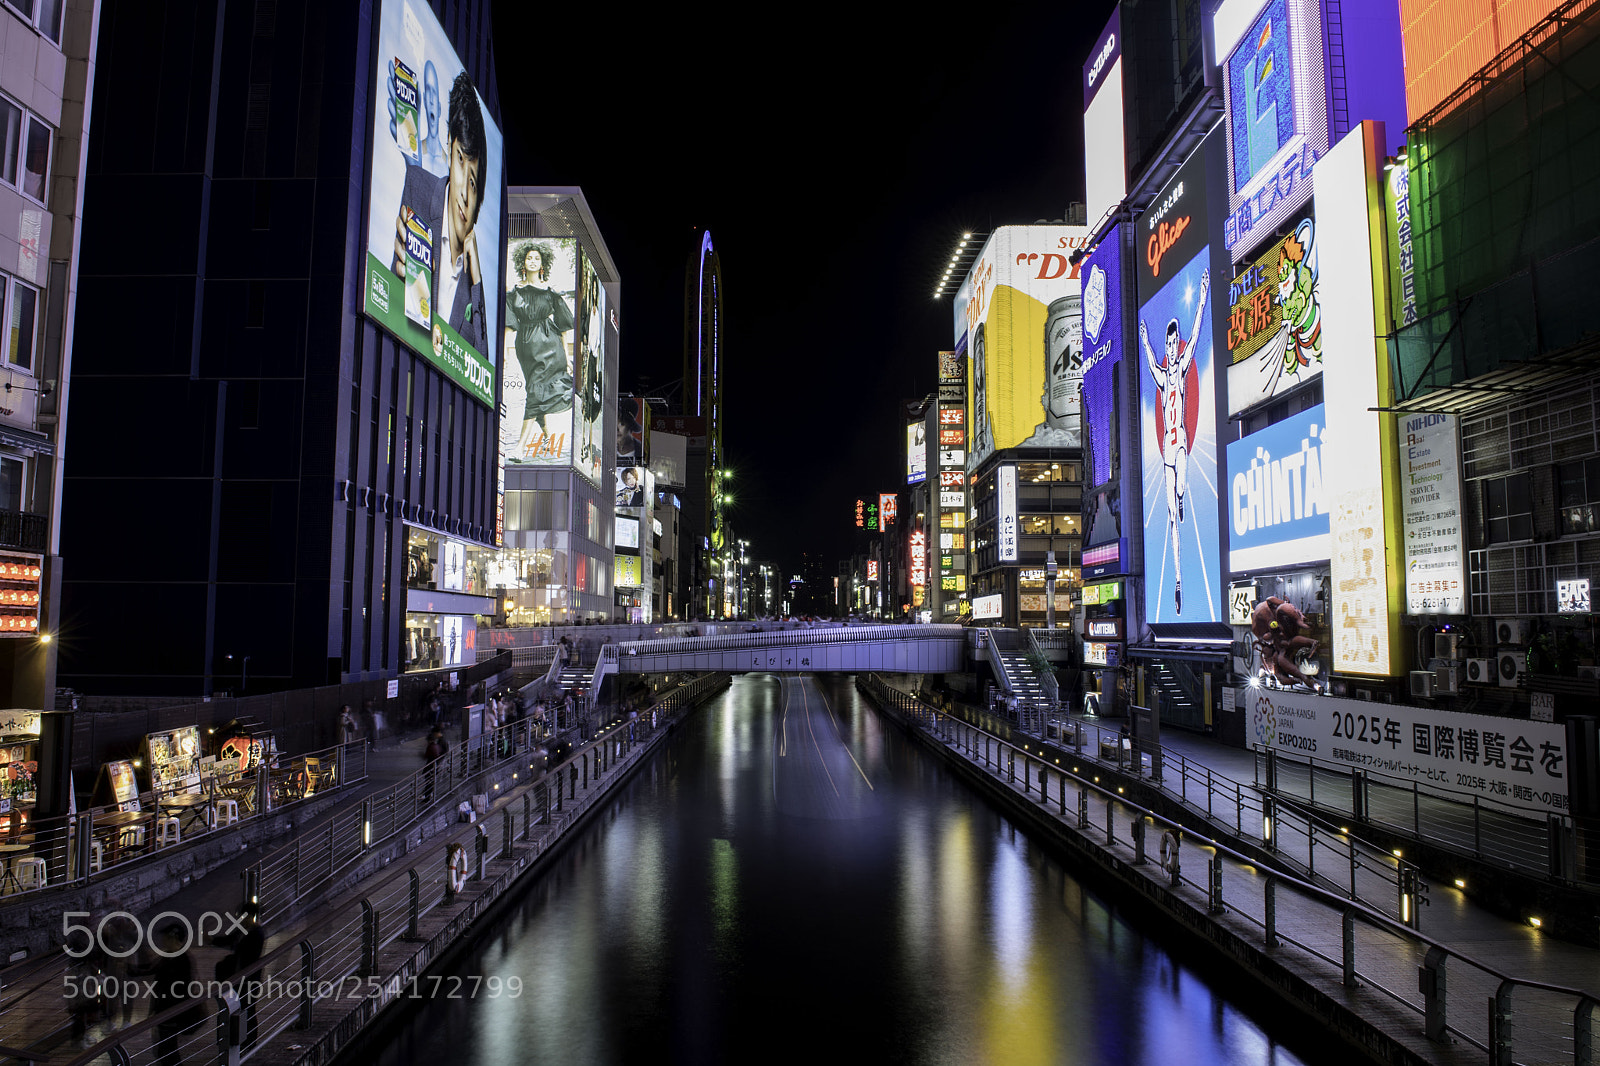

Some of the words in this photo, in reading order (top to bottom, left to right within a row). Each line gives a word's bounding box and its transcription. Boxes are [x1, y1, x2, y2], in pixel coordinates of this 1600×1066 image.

[1149, 181, 1184, 230] おいしさと健康
[1224, 143, 1318, 250] 日商エステム
[408, 231, 432, 268] サロンパス
[1147, 215, 1190, 277] Glico
[1228, 264, 1267, 307] かぜに
[1226, 285, 1272, 351] 改源
[464, 350, 493, 398] サロンパス
[1168, 385, 1179, 446] グリコ
[1407, 413, 1447, 433] NIHON
[526, 432, 566, 459] H&M
[1408, 446, 1431, 460] Estate
[1408, 459, 1442, 473] Investment
[1408, 472, 1443, 486] Technology
[1409, 484, 1435, 496] SERVICE
[1410, 492, 1441, 505] PROVIDER
[1004, 515, 1014, 557] かに道楽
[909, 531, 925, 586] 大阪王将
[1559, 582, 1590, 602] BAR
[1095, 621, 1117, 635] LOTTERIA
[1277, 705, 1316, 720] OSAKA-KANSAI
[1531, 694, 1554, 709] BAR
[1278, 718, 1294, 729] JAPAN
[1332, 711, 1402, 750] 2025年
[1412, 722, 1564, 779] 国際博覧会を
[1456, 773, 1487, 791] 2025年
